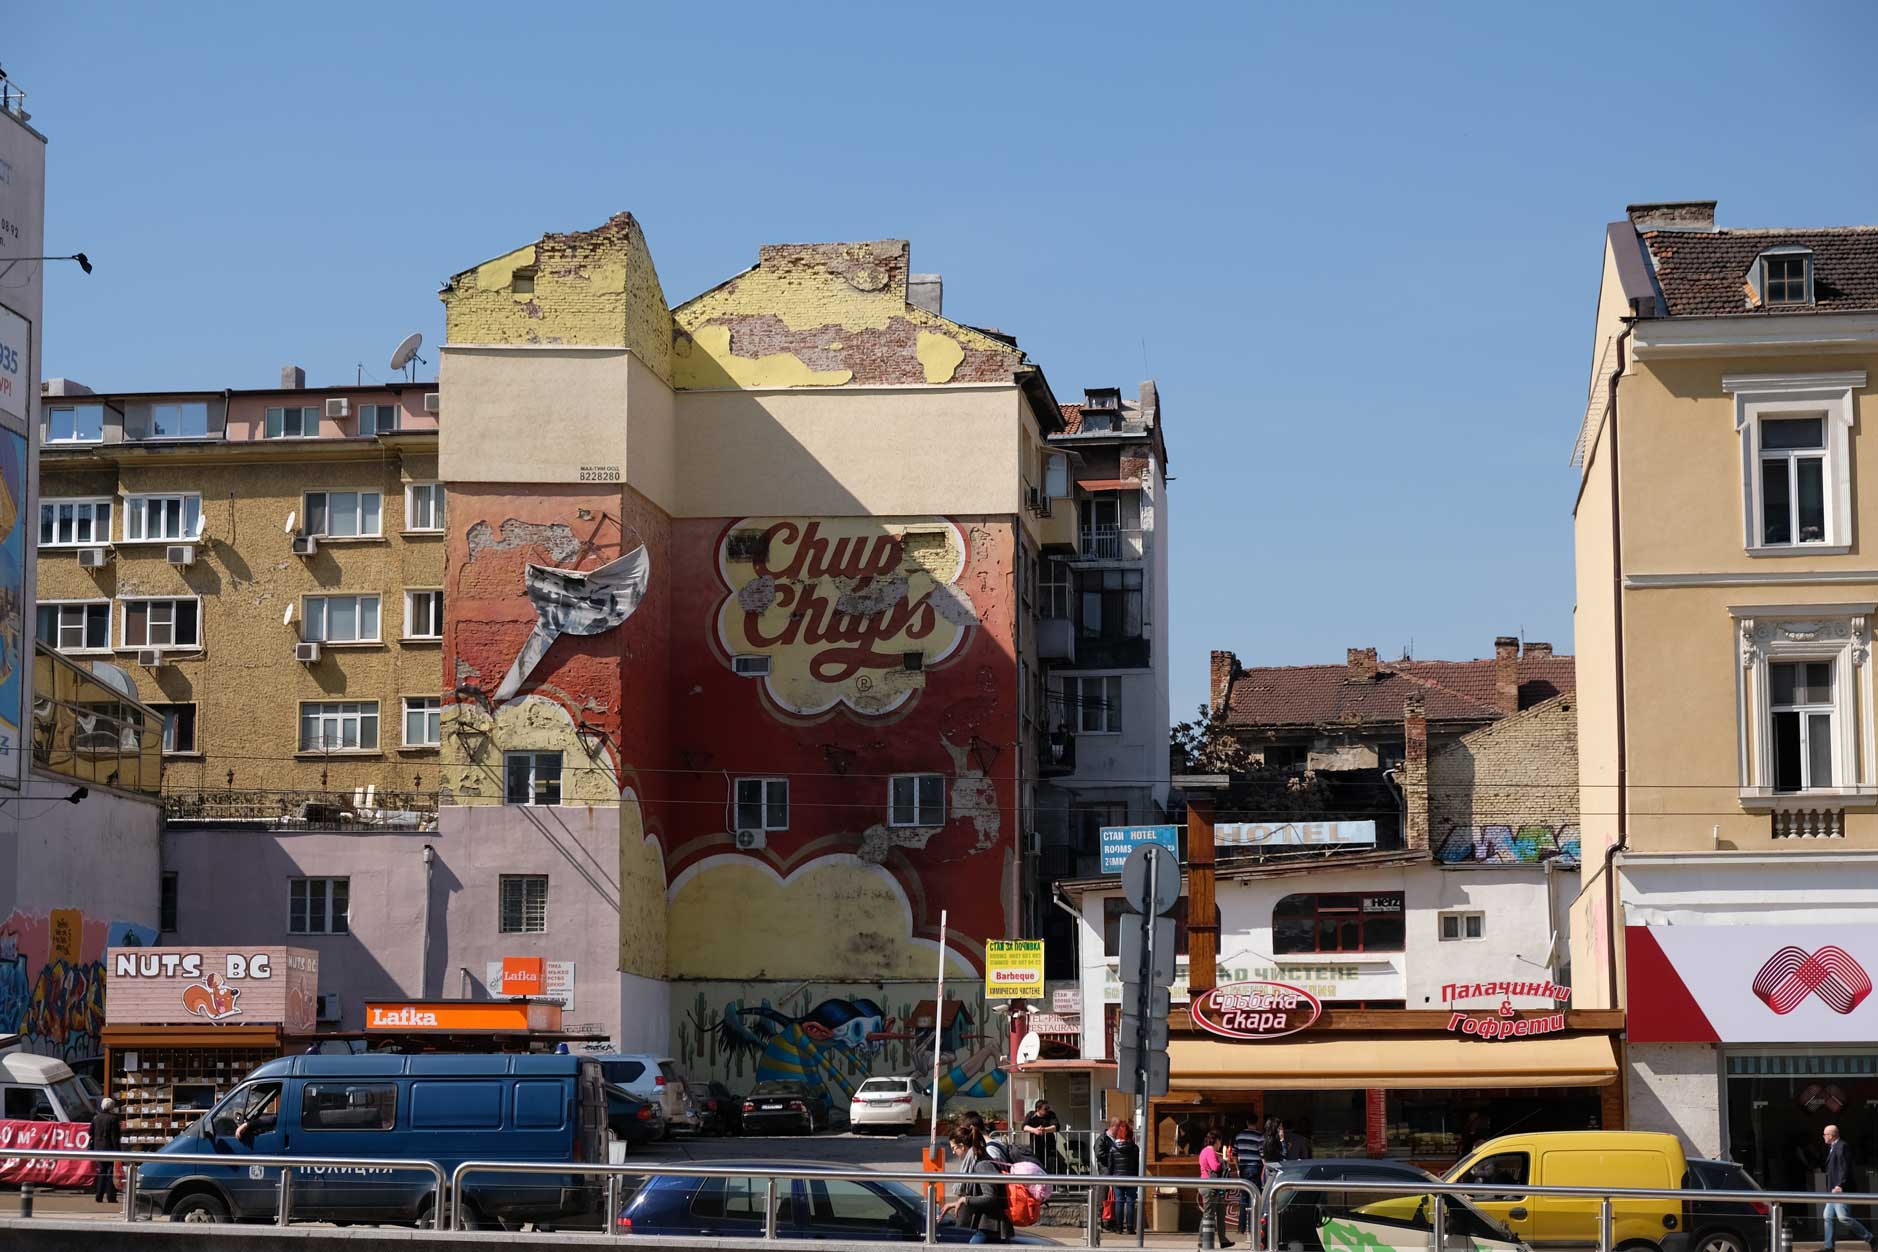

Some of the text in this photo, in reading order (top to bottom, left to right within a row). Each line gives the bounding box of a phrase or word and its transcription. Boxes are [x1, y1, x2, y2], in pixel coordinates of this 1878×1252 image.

[580, 471, 620, 480] 8228280
[752, 521, 902, 592] Chup
[743, 582, 936, 683] Chups
[1130, 830, 1157, 840] HOTEL
[1216, 823, 1350, 845] HOTEL
[1104, 845, 1132, 854] ROOMS
[116, 953, 271, 979] NUTS BG
[503, 971, 537, 981] Lafka
[1209, 989, 1298, 1012] Сръбска
[1441, 980, 1571, 1003] Палачинки
[373, 1008, 438, 1026] Lafka
[1499, 1000, 1514, 1016] &
[1222, 1011, 1286, 1032] скара
[1448, 1012, 1565, 1039] Гофрети
